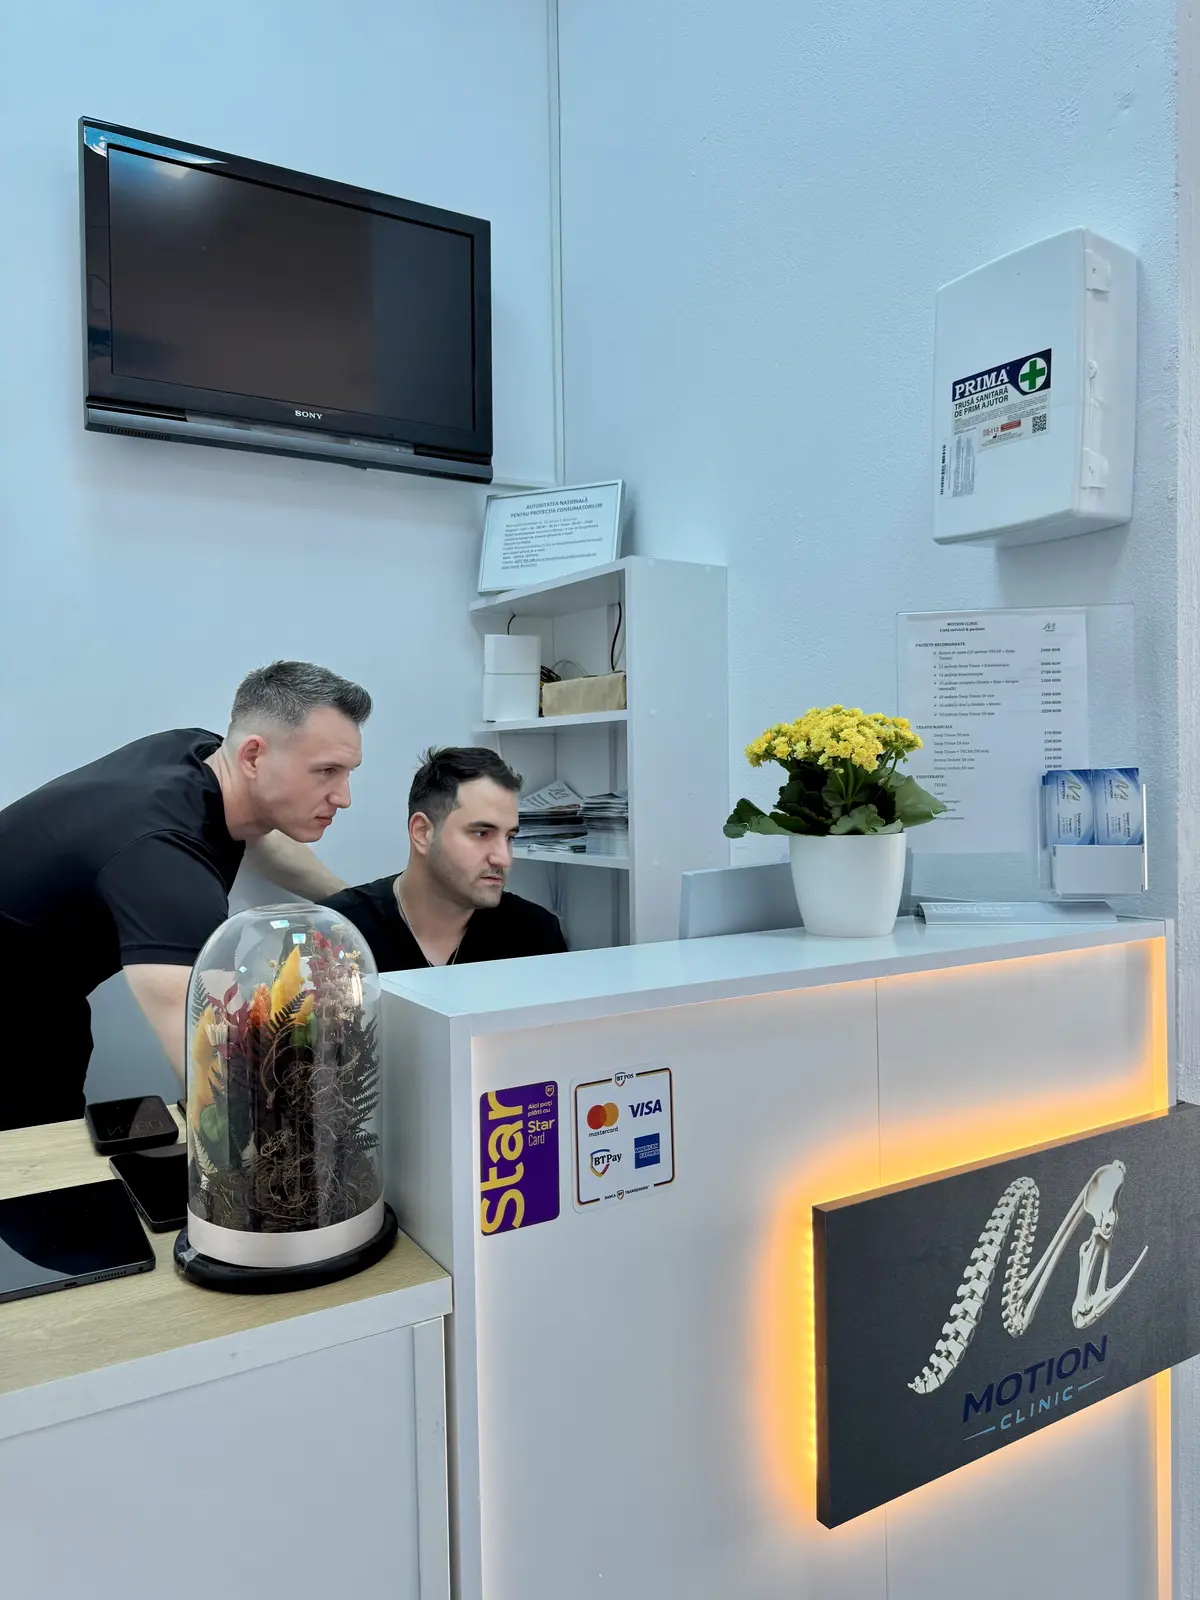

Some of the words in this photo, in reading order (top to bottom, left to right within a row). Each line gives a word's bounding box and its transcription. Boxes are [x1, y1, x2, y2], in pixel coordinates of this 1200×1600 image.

[954, 368, 1010, 400] PRIMA
[954, 398, 975, 410] TRUSĂ
[976, 386, 1008, 404] SANITARĂ
[954, 410, 963, 418] DE
[964, 404, 980, 416] PRIM
[981, 395, 1008, 410] AJUTOR
[294, 410, 322, 420] SONY
[526, 501, 559, 510] AUTORITATEA
[556, 503, 603, 512] CONSUMATORILOR
[628, 1099, 662, 1118] VISA
[527, 1119, 555, 1133] Star
[589, 1126, 619, 1138] mastercard
[528, 1132, 545, 1146] Card
[962, 1334, 1108, 1423] MOTION
[1000, 1385, 1073, 1430] CLINIC
